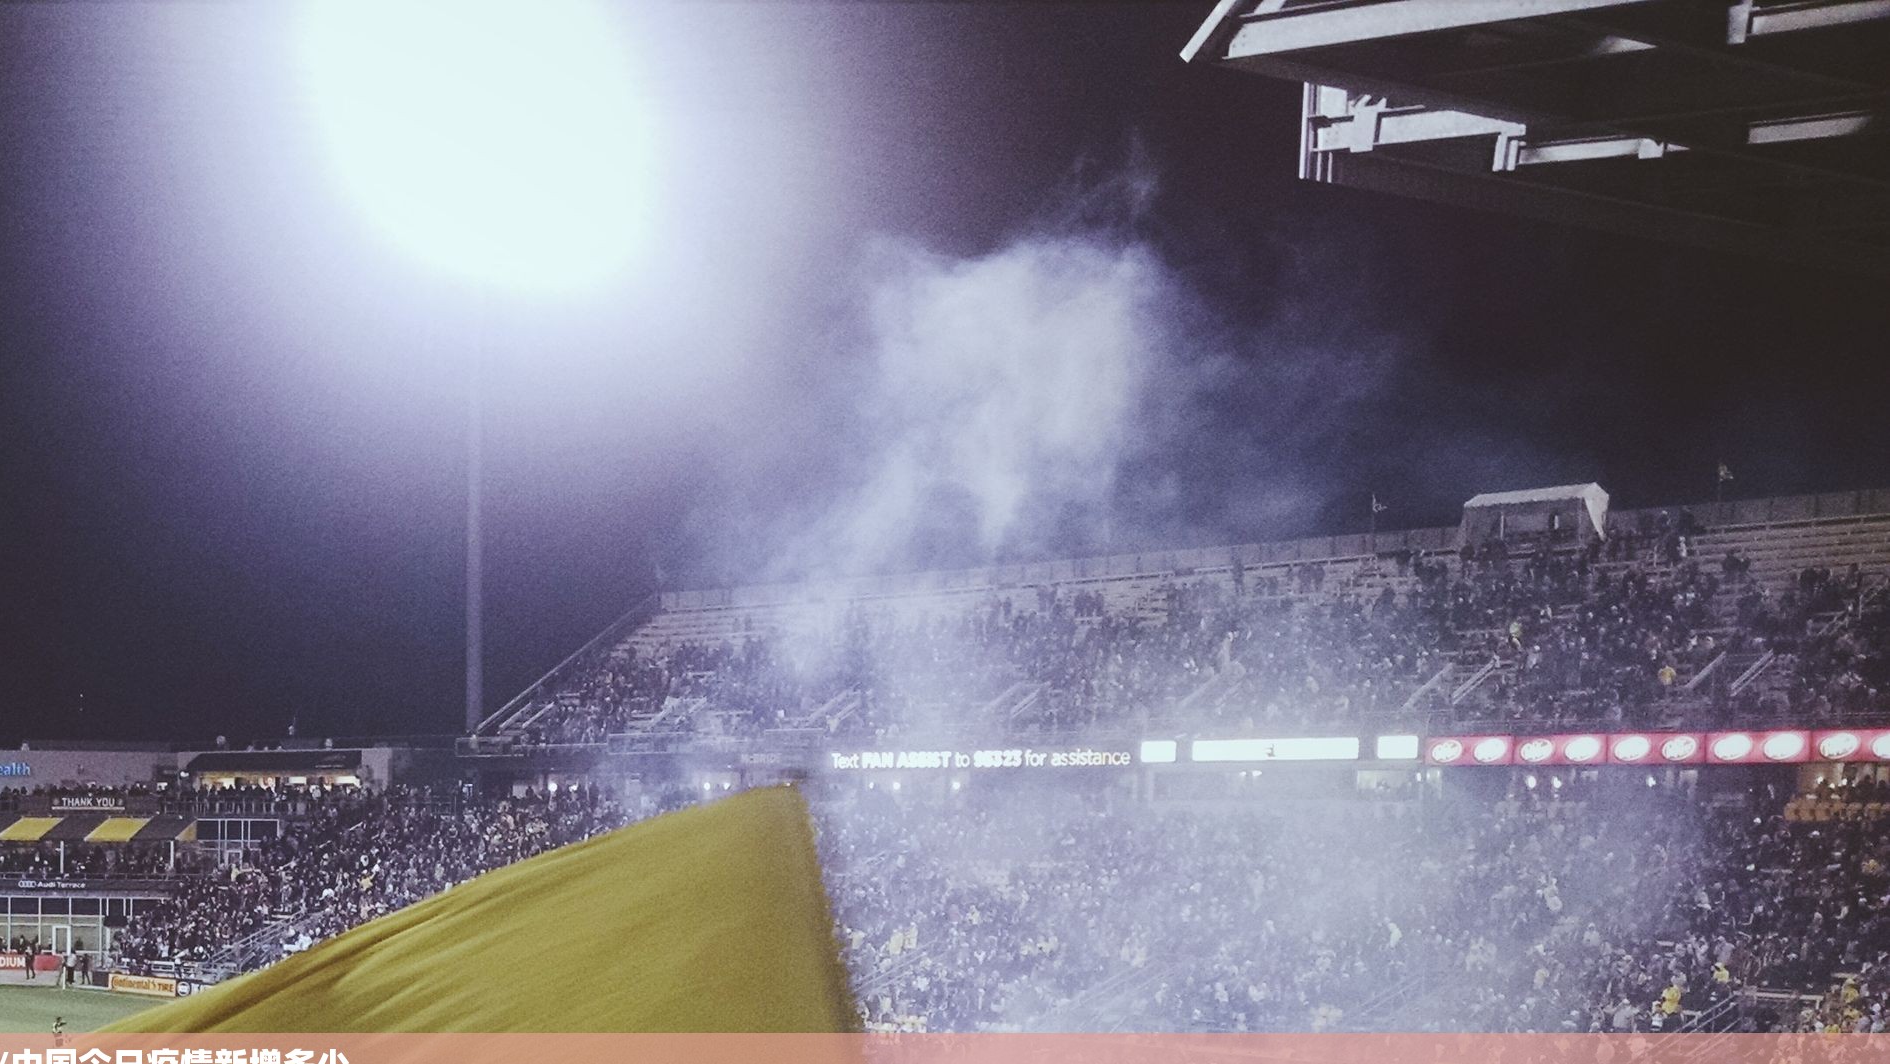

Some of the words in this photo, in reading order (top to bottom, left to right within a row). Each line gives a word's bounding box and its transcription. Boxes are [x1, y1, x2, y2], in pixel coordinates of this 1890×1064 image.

[831, 752, 859, 769] Text
[861, 751, 894, 769] FAN
[896, 751, 952, 769] ASSIST
[955, 752, 971, 767] to
[1025, 749, 1047, 766] for
[1050, 749, 1130, 766] assistance
[62, 797, 93, 807] THANK
[95, 798, 115, 807] YOU
[57, 881, 86, 889] Terrace
[157, 983, 174, 992] TIRE
